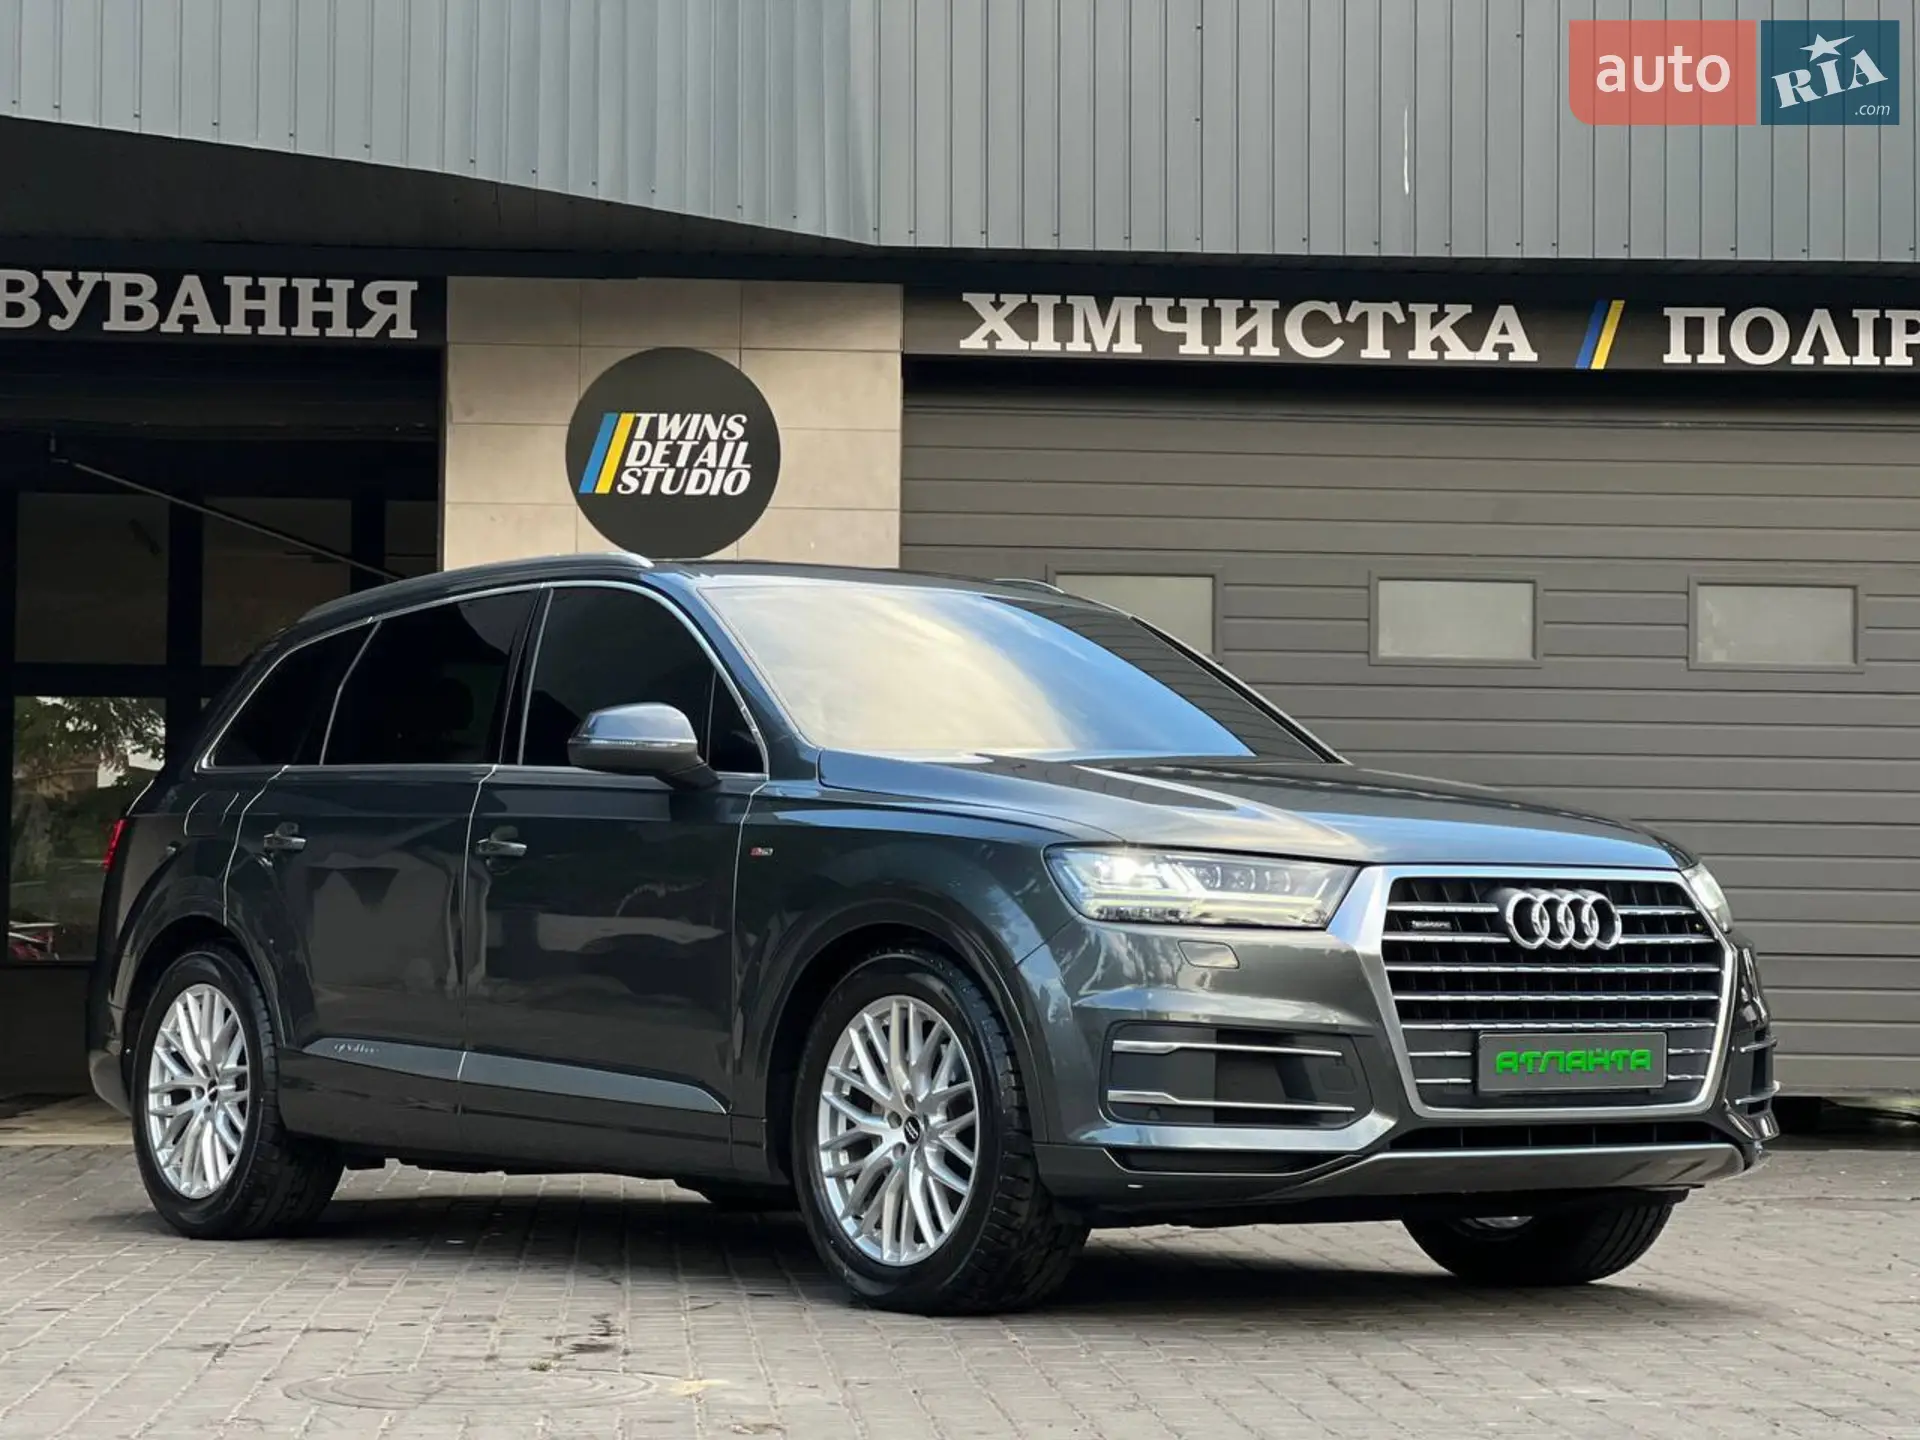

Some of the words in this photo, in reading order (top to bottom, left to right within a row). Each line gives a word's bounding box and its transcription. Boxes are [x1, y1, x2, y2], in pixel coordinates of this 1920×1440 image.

[0, 269, 418, 339] ВУВАННЯ
[959, 292, 1538, 362] ХІМЧИСТКА
[634, 413, 747, 441] TWINS
[625, 441, 752, 469] DETAIL
[616, 468, 751, 496] STUDIO
